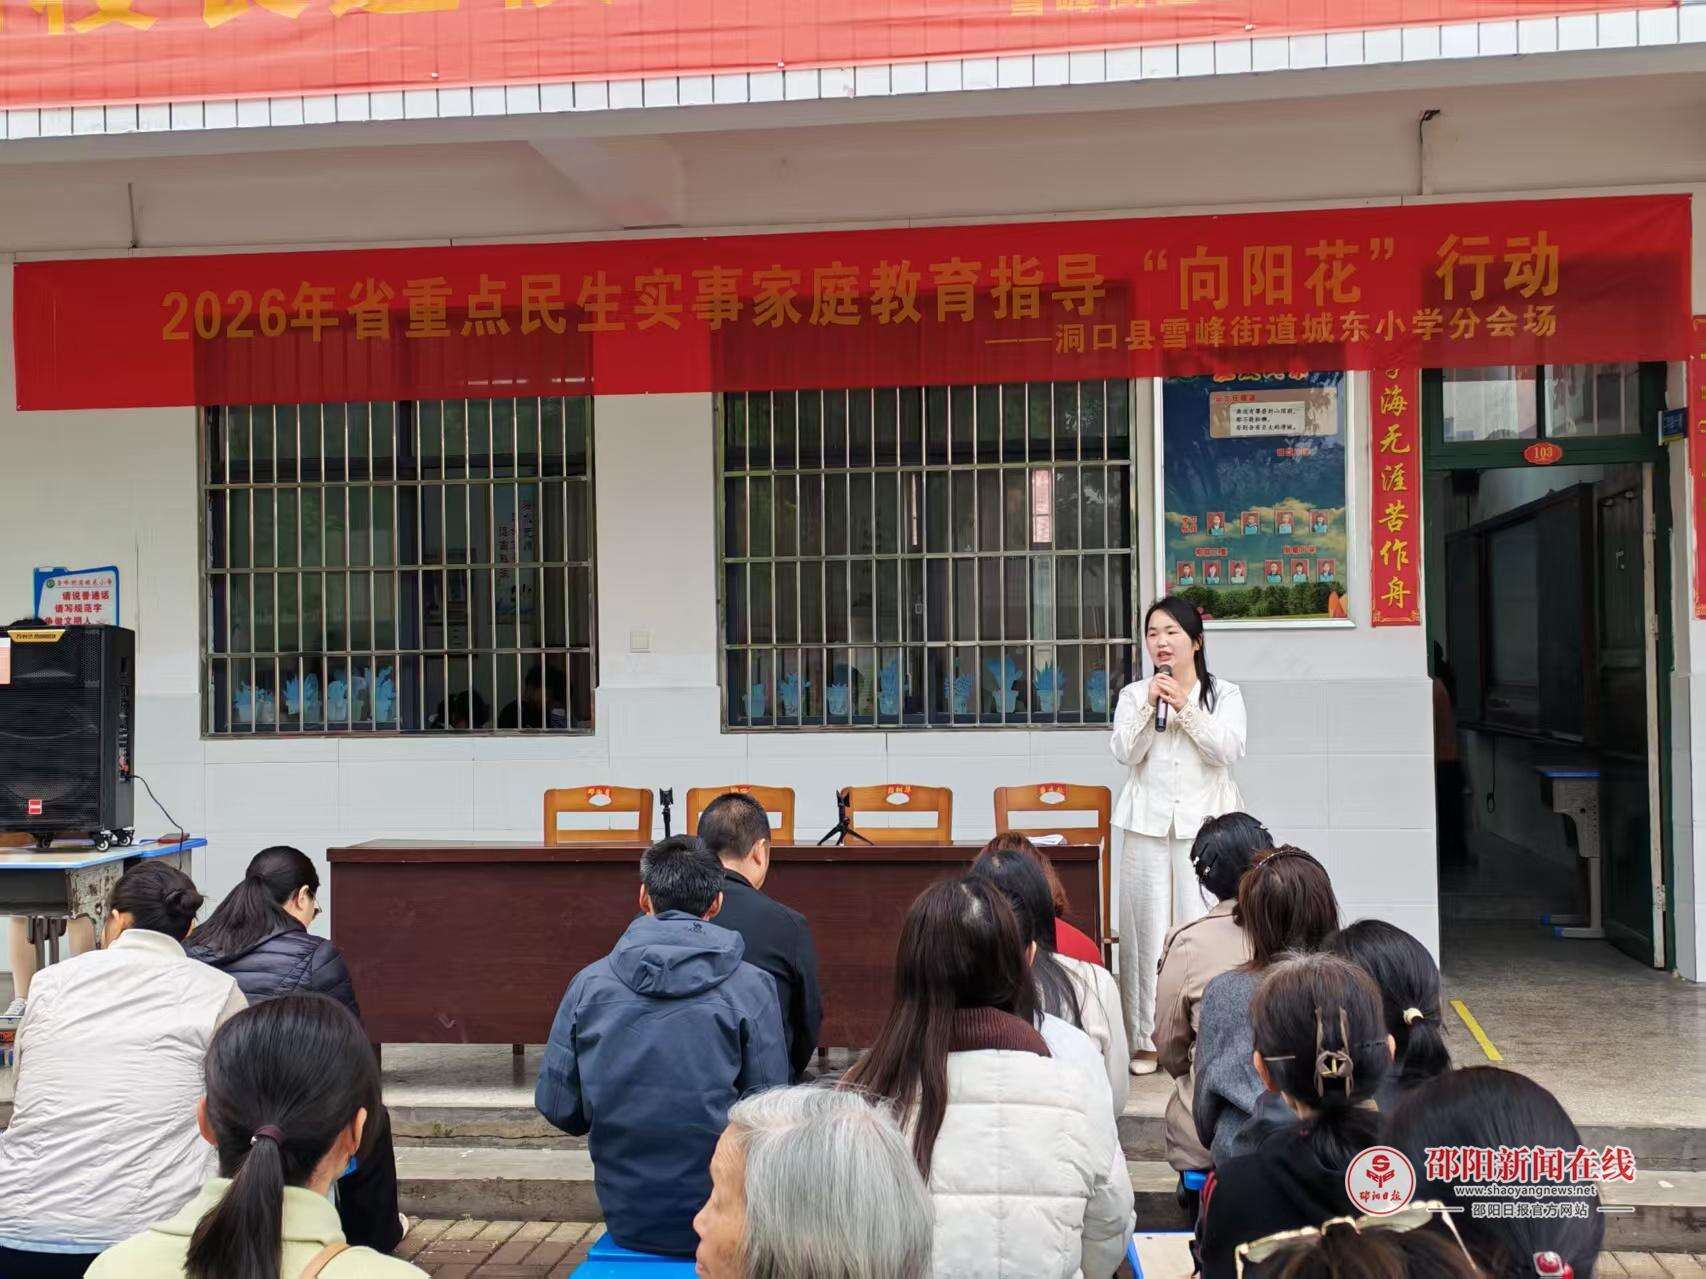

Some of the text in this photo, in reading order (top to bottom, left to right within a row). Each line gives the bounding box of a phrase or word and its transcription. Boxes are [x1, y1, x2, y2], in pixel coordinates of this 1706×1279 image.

[1533, 446, 1553, 459] 103
[62, 591, 110, 600] 请说普通话
[55, 603, 102, 613] 请写规范字
